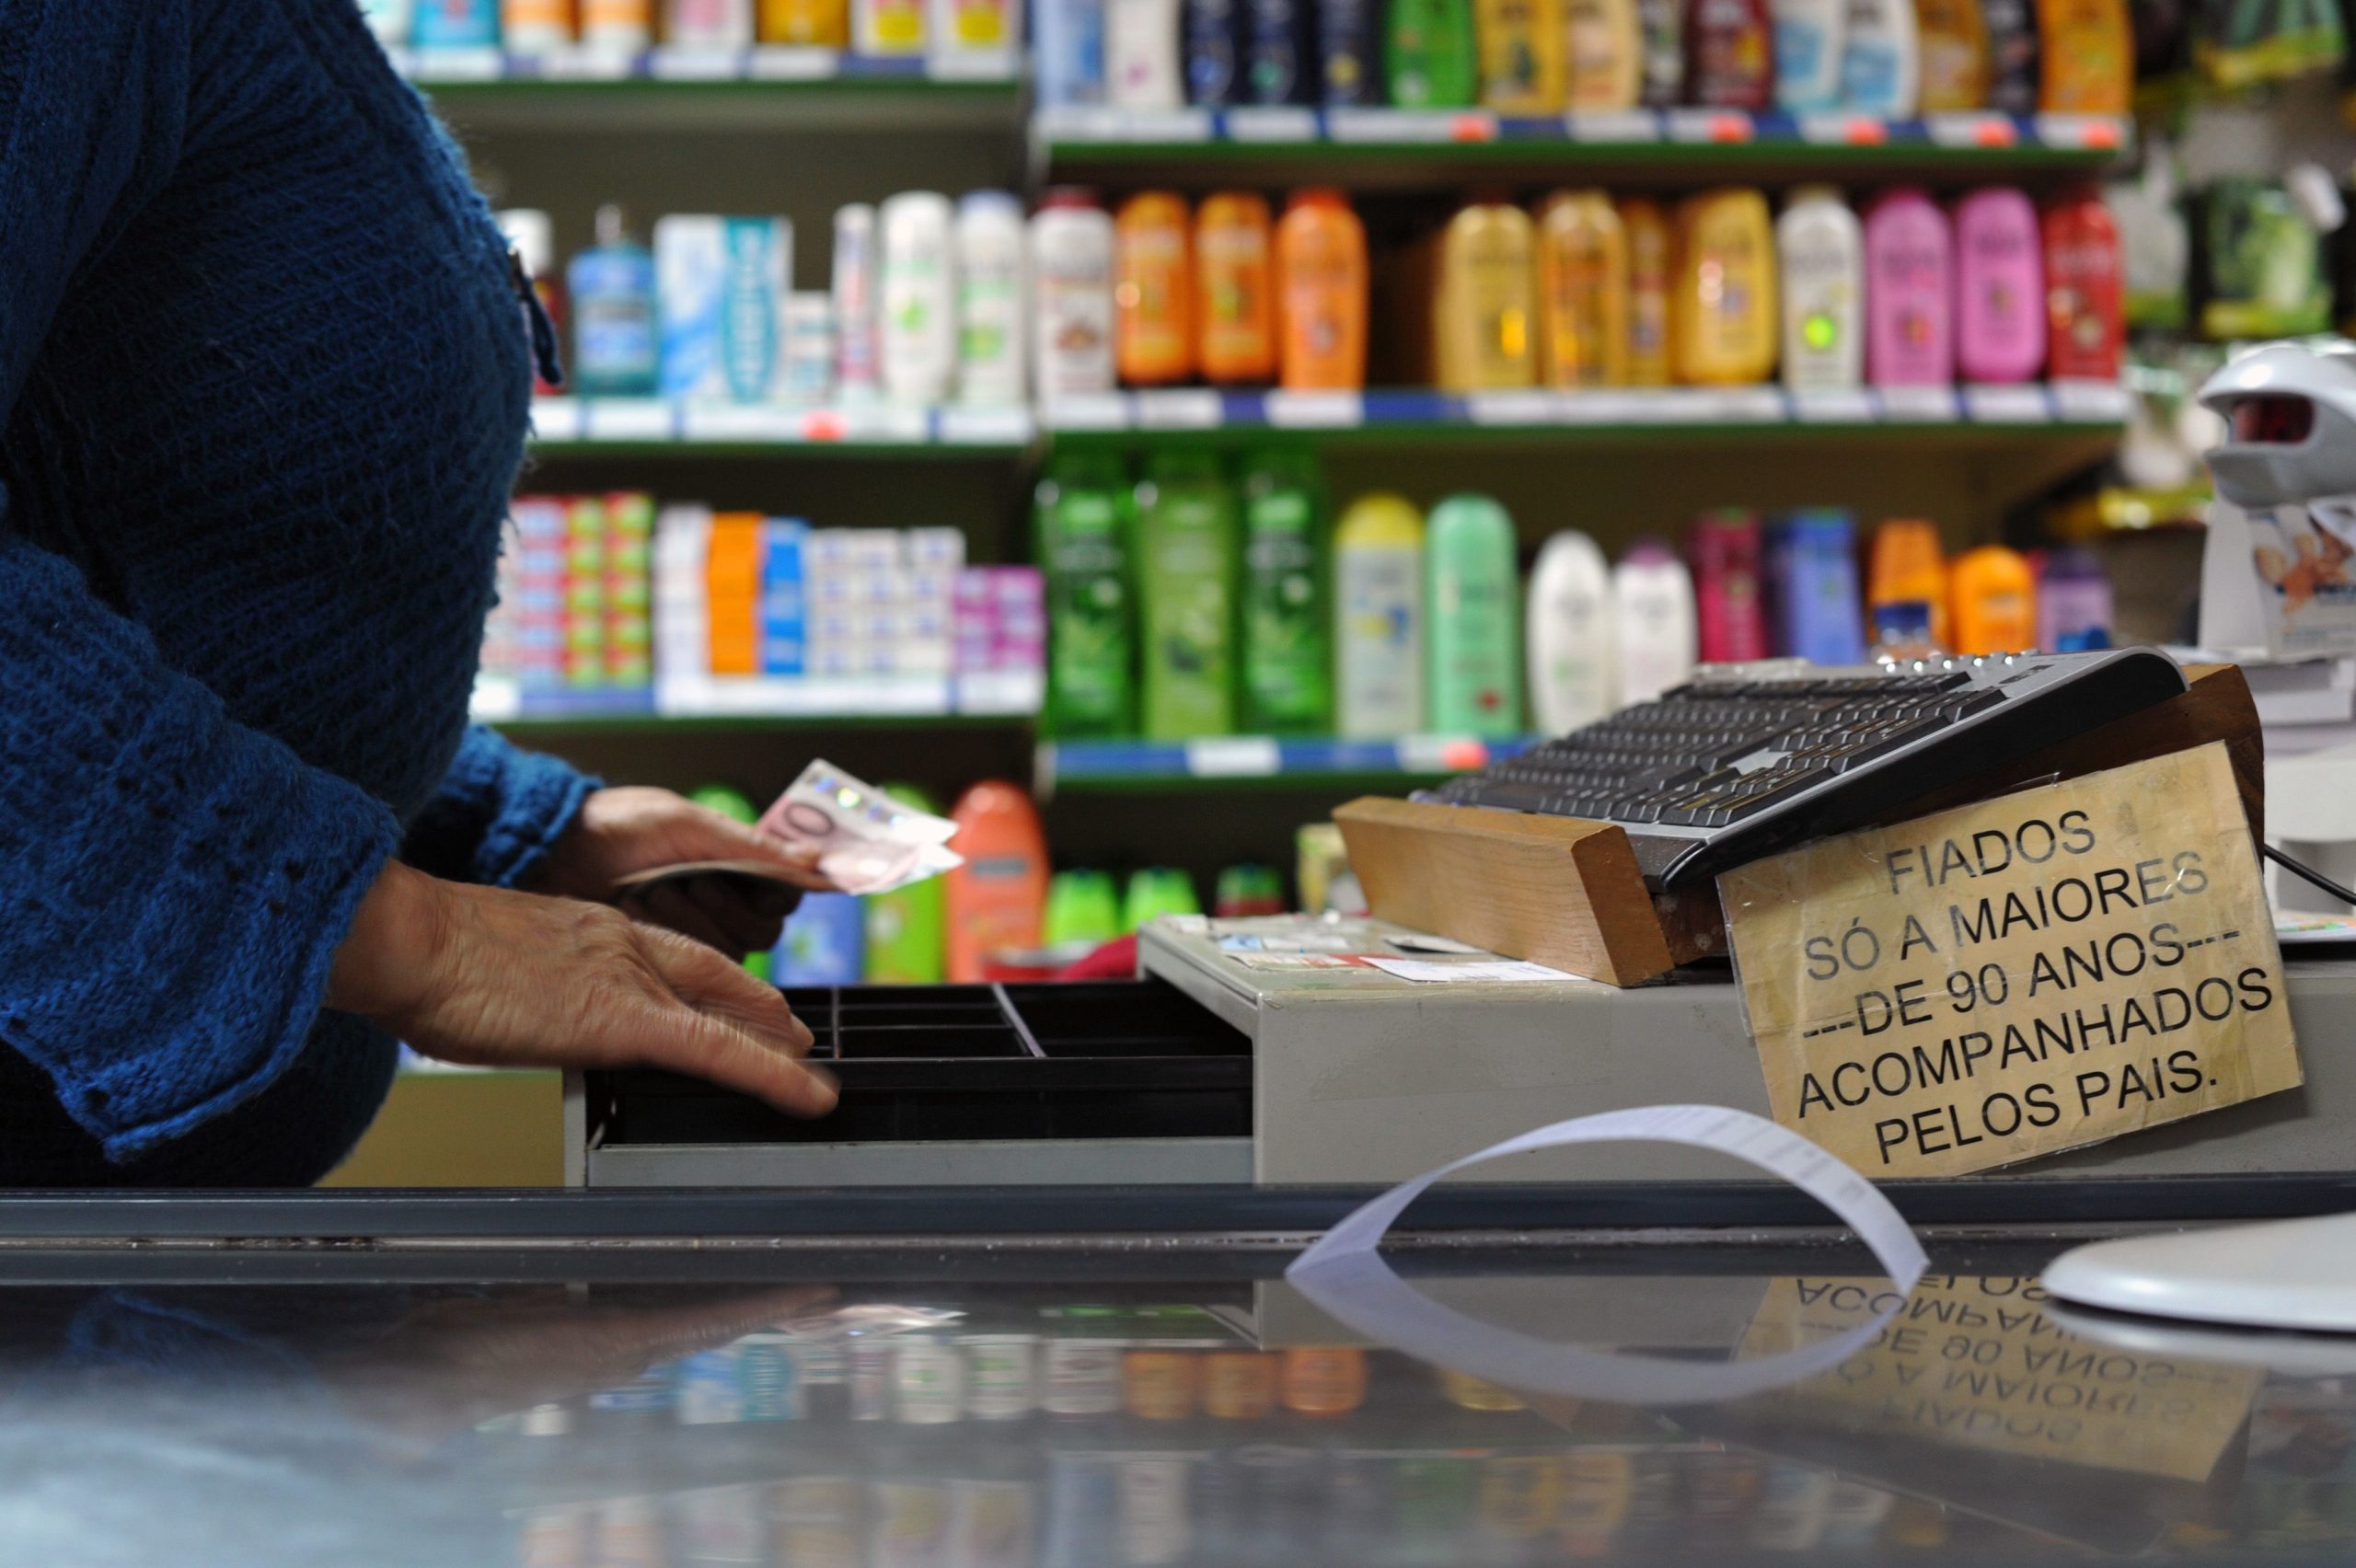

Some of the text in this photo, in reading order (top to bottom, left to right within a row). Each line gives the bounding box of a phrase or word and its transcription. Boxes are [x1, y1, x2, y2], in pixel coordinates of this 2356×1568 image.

[1887, 811, 2096, 894] FIADOS
[1805, 851, 2209, 981] SÓ A MAIORES
[1798, 968, 2272, 1119] ACOMPANHADOS
[1946, 963, 2008, 1013] 90
[1875, 1083, 2061, 1165] PELOS
[2076, 1051, 2218, 1117] PAIS.
